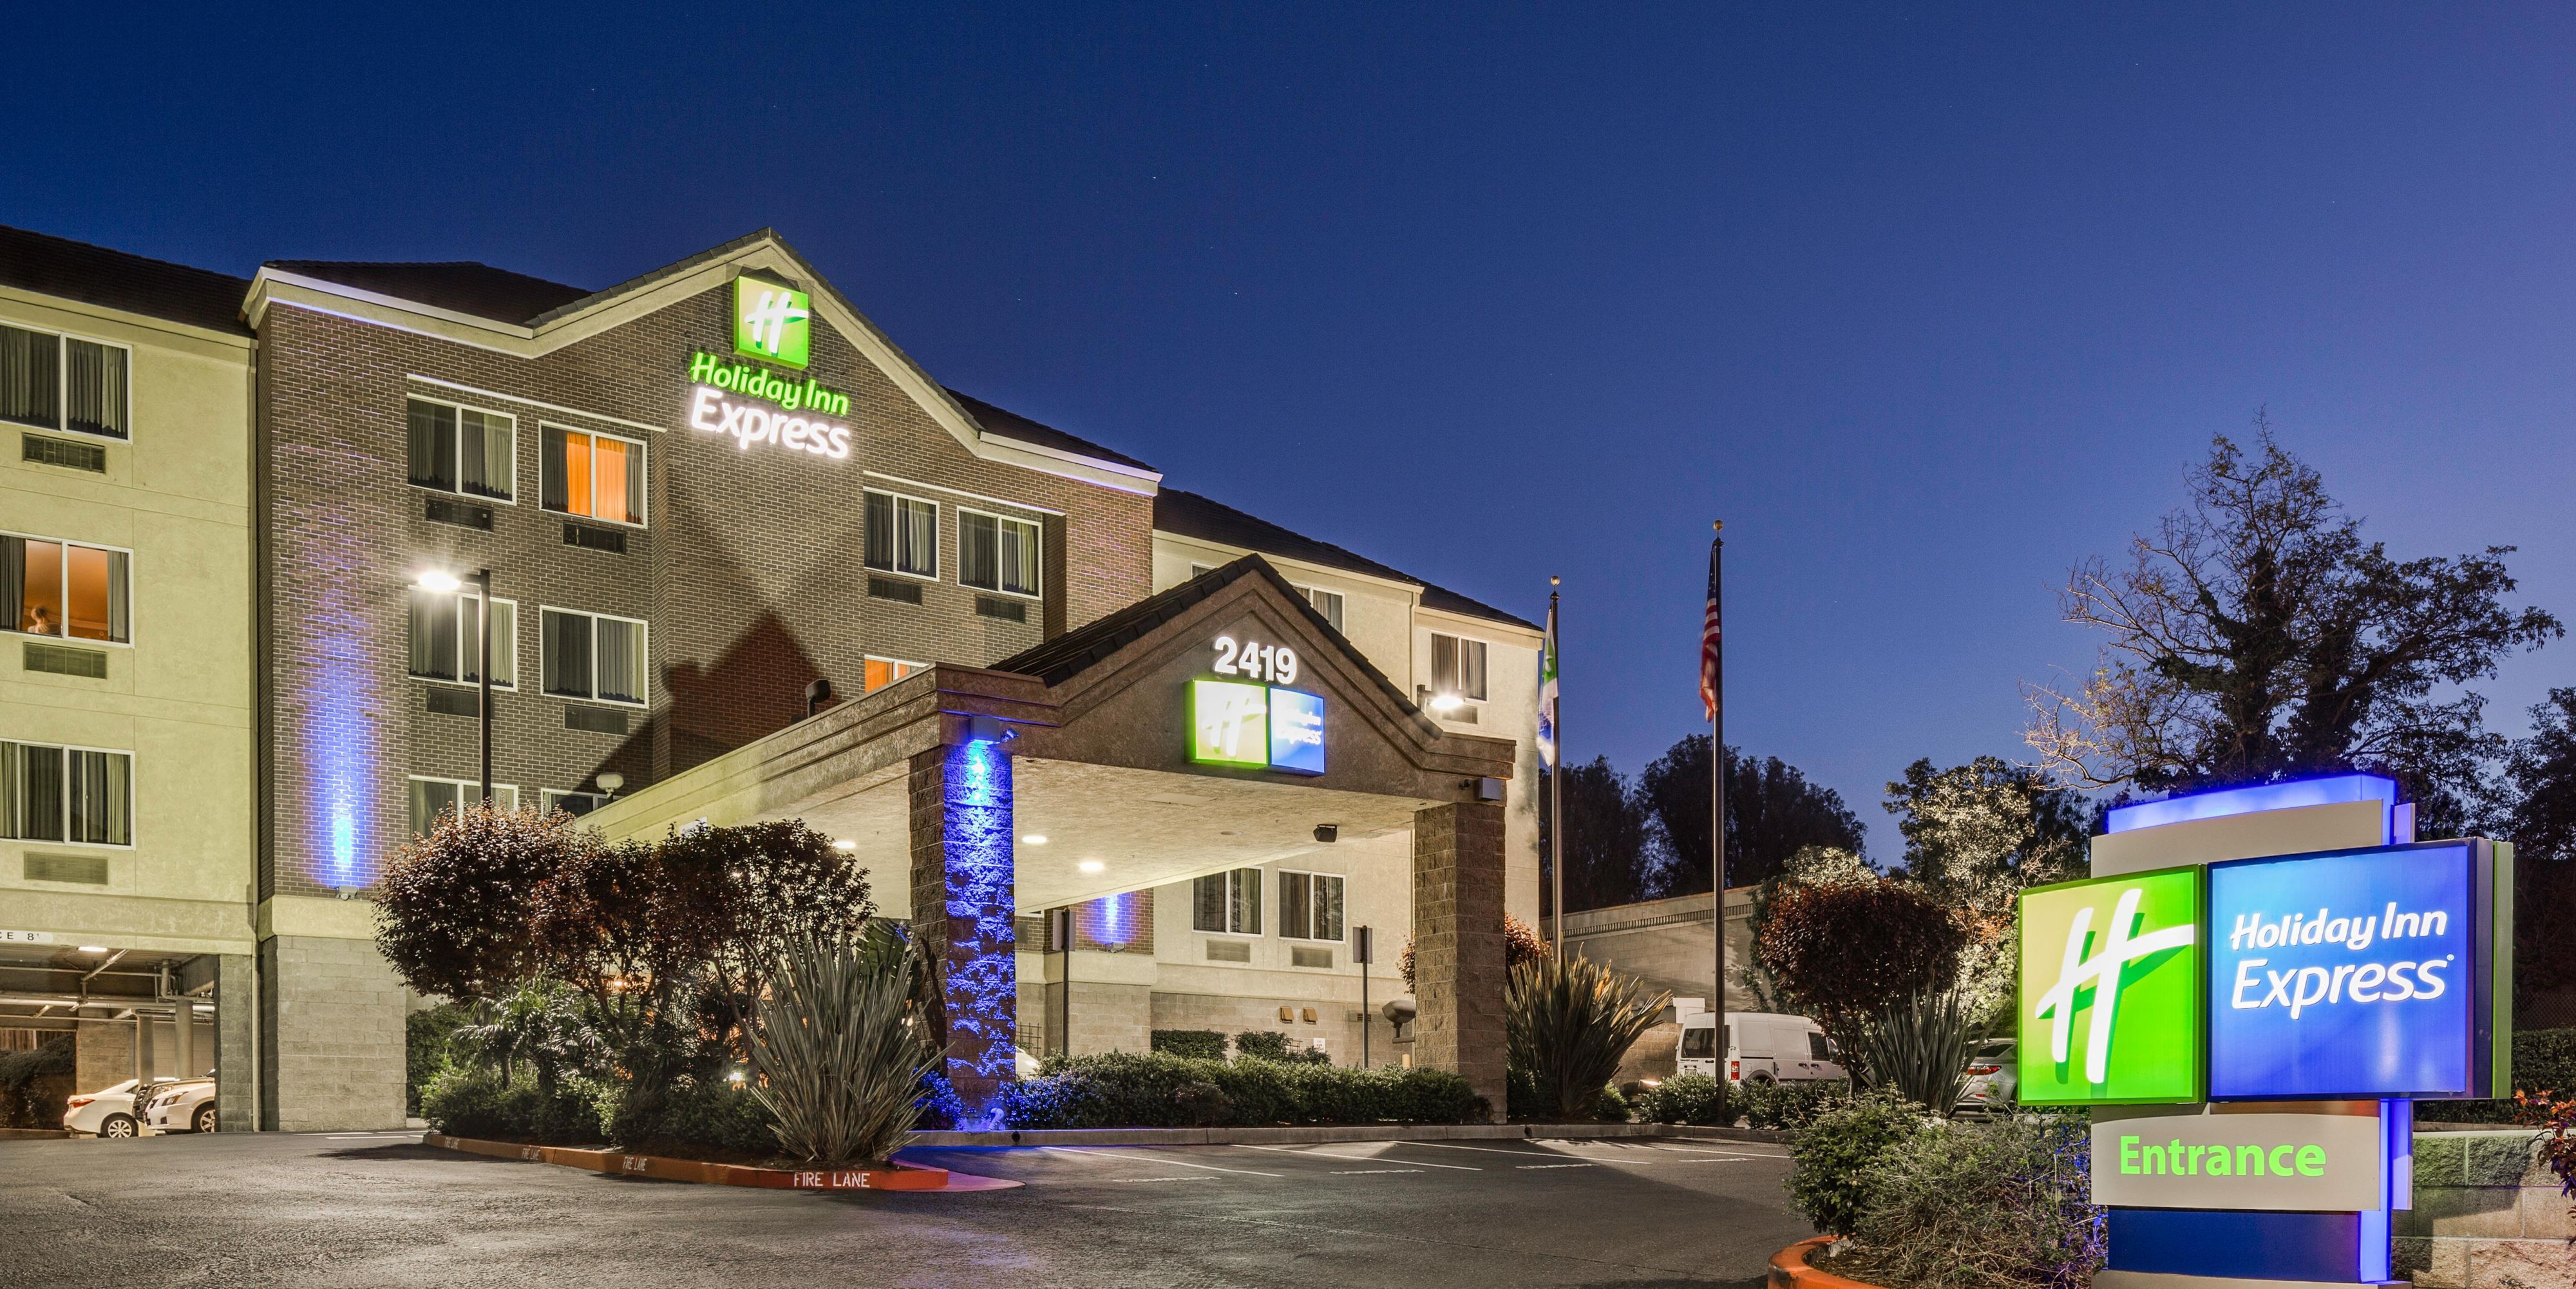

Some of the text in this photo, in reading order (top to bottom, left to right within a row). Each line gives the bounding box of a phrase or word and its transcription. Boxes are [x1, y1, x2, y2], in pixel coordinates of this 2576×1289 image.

[689, 352, 849, 416] Holiday Inn
[691, 387, 851, 459] Express
[1214, 636, 1297, 684] 2419
[2230, 902, 2447, 950] Holiday Inn
[794, 1172, 870, 1187] FIRE LANE
[2120, 1136, 2327, 1177] Entrance
